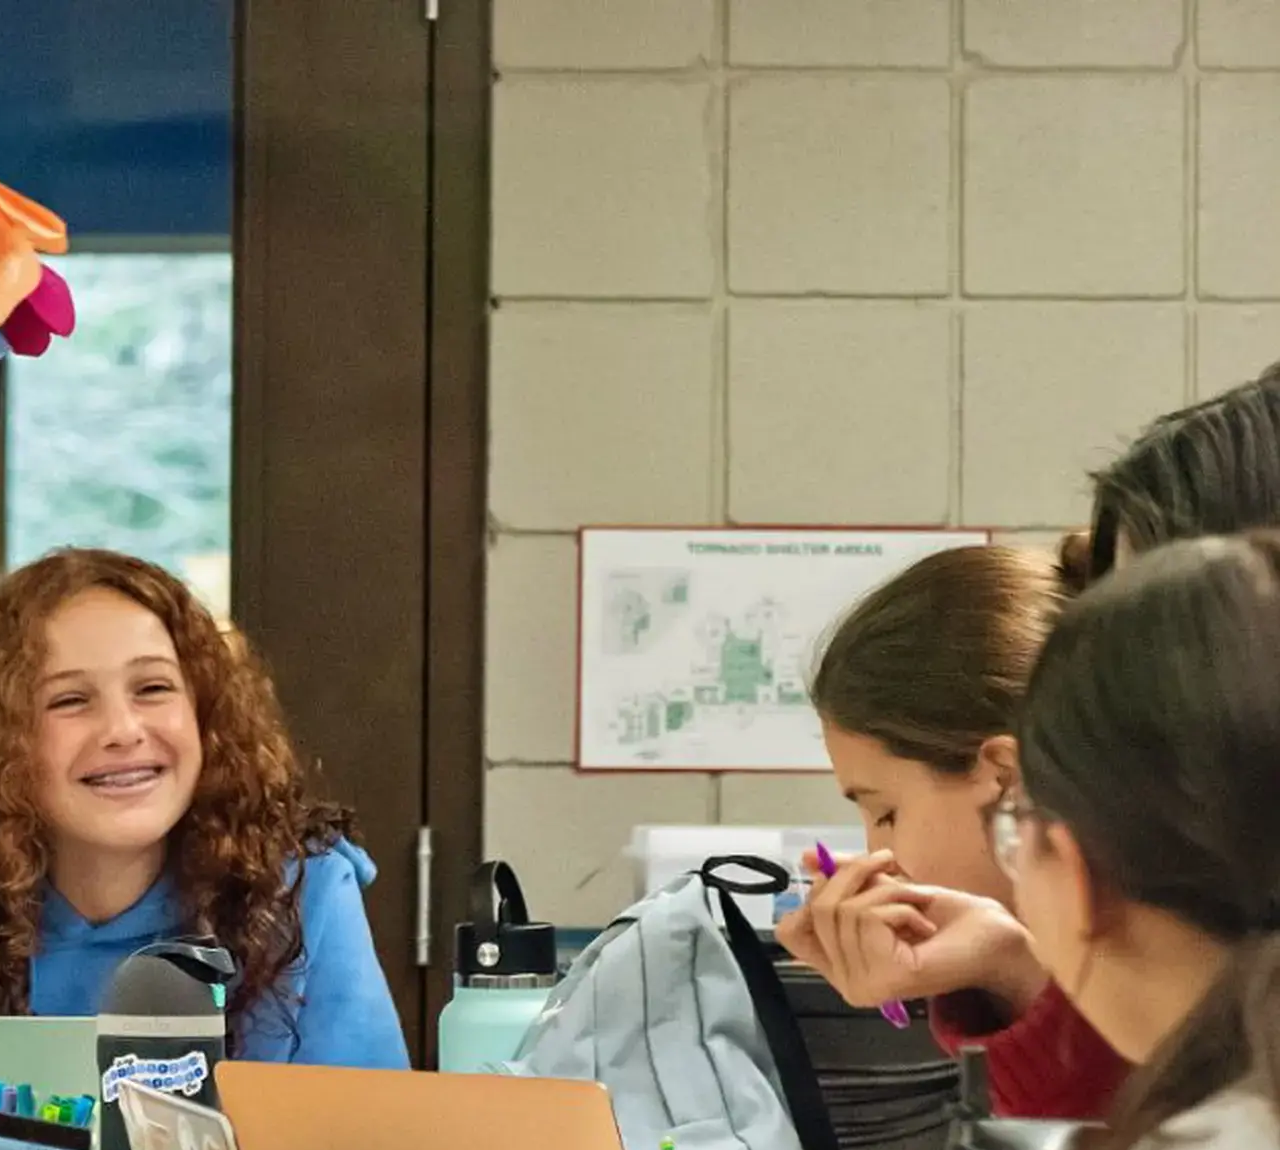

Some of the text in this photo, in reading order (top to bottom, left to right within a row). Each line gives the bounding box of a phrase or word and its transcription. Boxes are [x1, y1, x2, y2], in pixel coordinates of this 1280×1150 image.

[687, 541, 883, 555] TORNADO SHELTER AREAS
